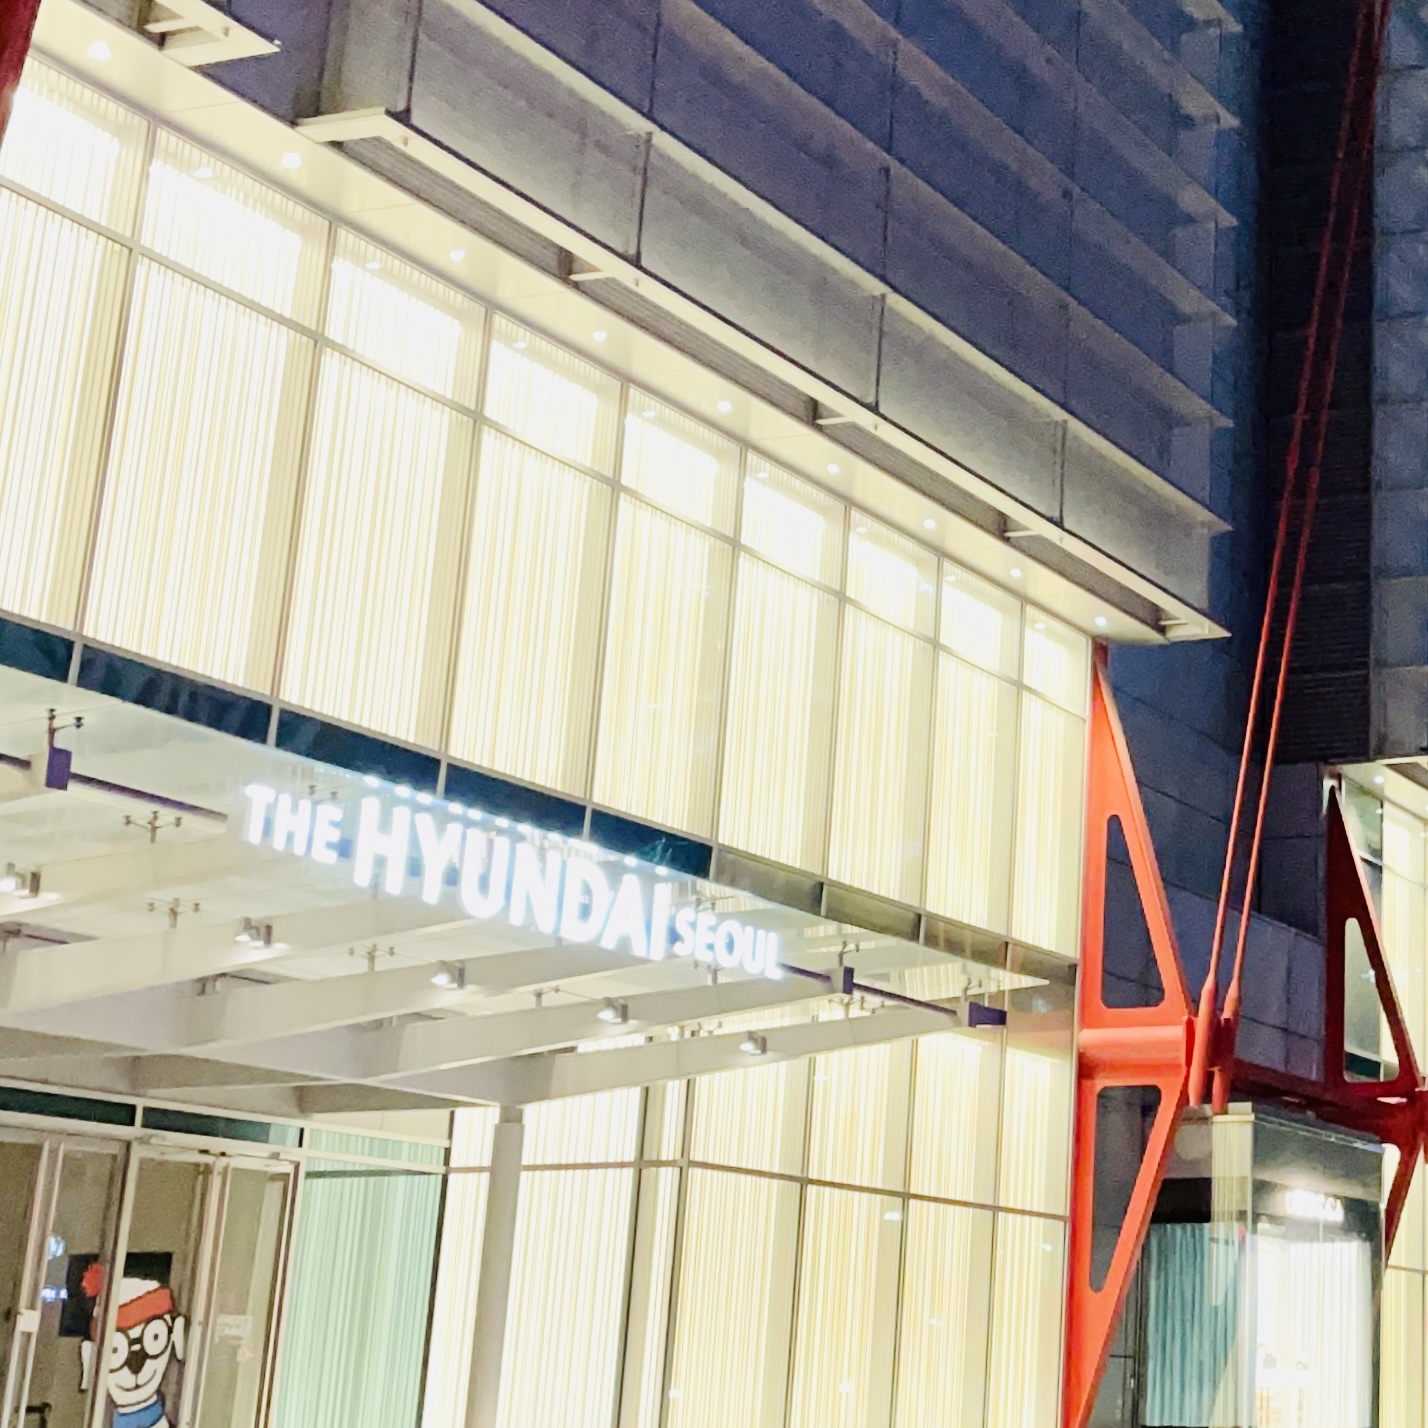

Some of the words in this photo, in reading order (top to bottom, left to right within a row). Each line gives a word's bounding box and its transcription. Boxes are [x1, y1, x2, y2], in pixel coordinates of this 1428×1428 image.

[244, 784, 343, 865] THE
[353, 796, 672, 961] HYUNDAI
[673, 907, 783, 980] SEOUL
